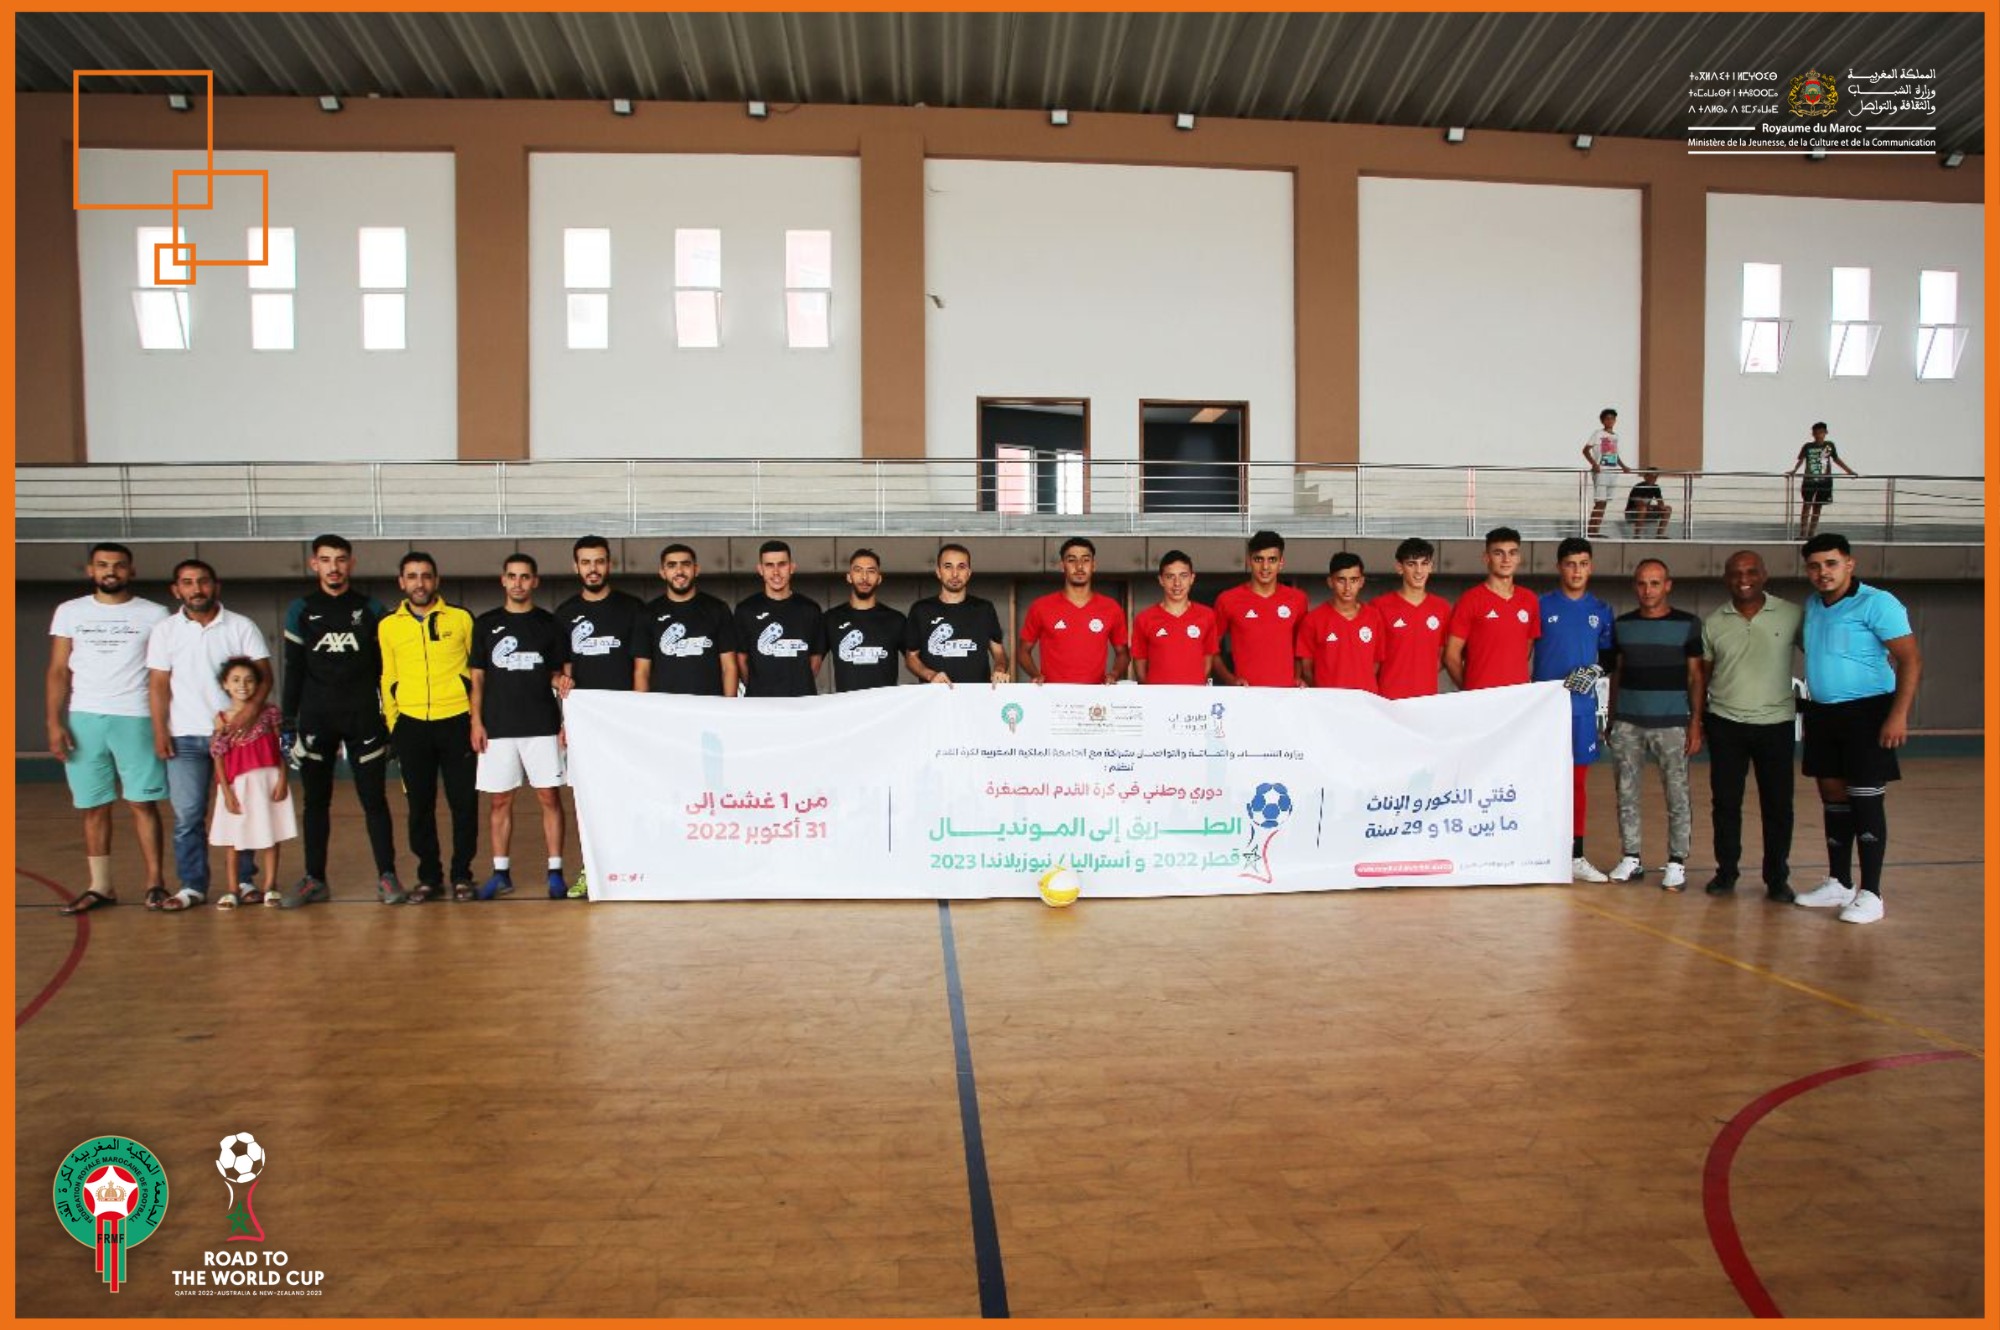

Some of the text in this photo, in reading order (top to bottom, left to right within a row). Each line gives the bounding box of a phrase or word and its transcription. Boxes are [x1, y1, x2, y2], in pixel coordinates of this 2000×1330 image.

[312, 632, 360, 652] AXA
[1088, 751, 1102, 760] مع
[985, 780, 1223, 804] دوري وطني في كرة القدم المصغرة
[1366, 784, 1517, 816] فئتي الذكور و الإناث
[686, 791, 828, 816] من 1 غشت إلى
[687, 817, 827, 845] 31 أكتوبر 2022
[929, 816, 1241, 842] الطريق إلى المونديال
[1365, 816, 1519, 838] ما بين 18 و 29 سنة
[930, 854, 977, 869] 2023
[1071, 851, 1130, 873] أستراليا
[1136, 857, 1146, 872] و
[1153, 852, 1198, 867] 2022
[1201, 848, 1240, 871] قطر
